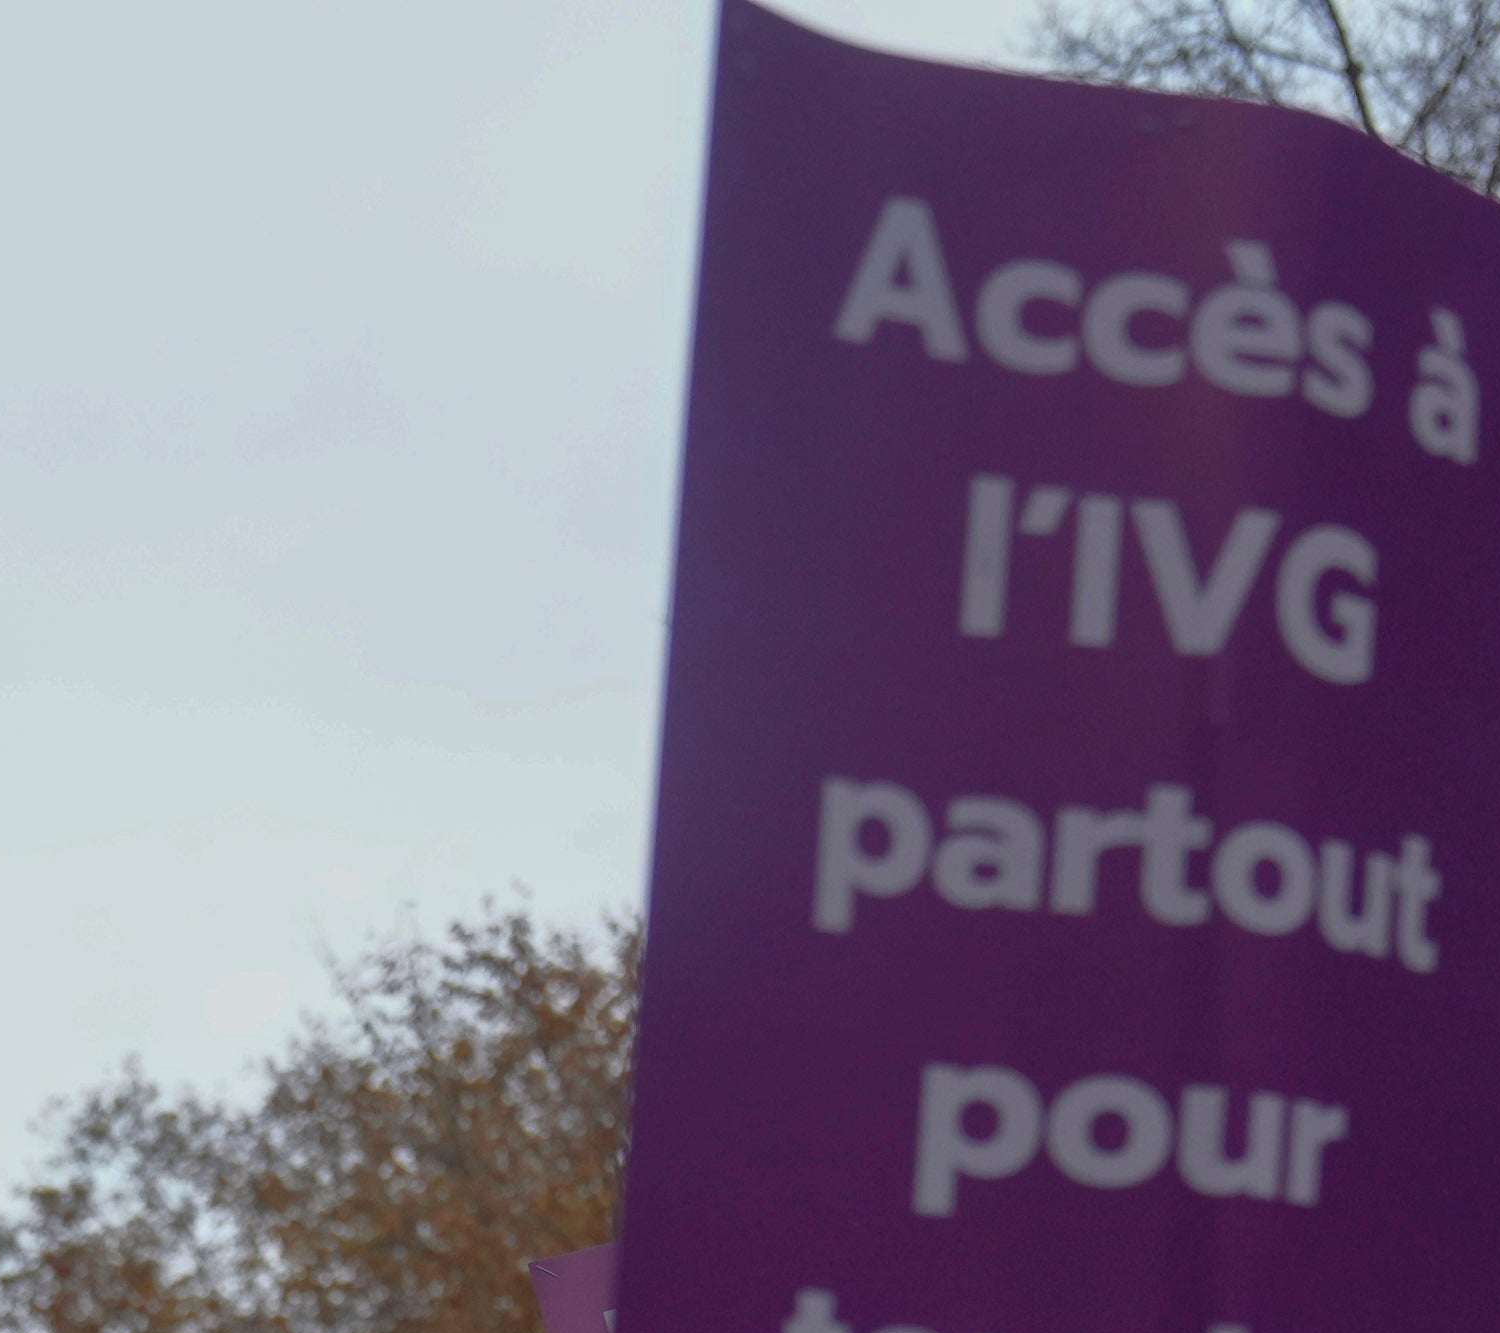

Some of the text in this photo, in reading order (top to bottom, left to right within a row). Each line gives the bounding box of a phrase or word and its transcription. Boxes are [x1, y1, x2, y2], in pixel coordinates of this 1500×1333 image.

[833, 194, 1481, 466] Accès à
[958, 474, 1380, 686] l'IVG
[810, 774, 1440, 975] partout
[911, 1060, 1349, 1218] pour
